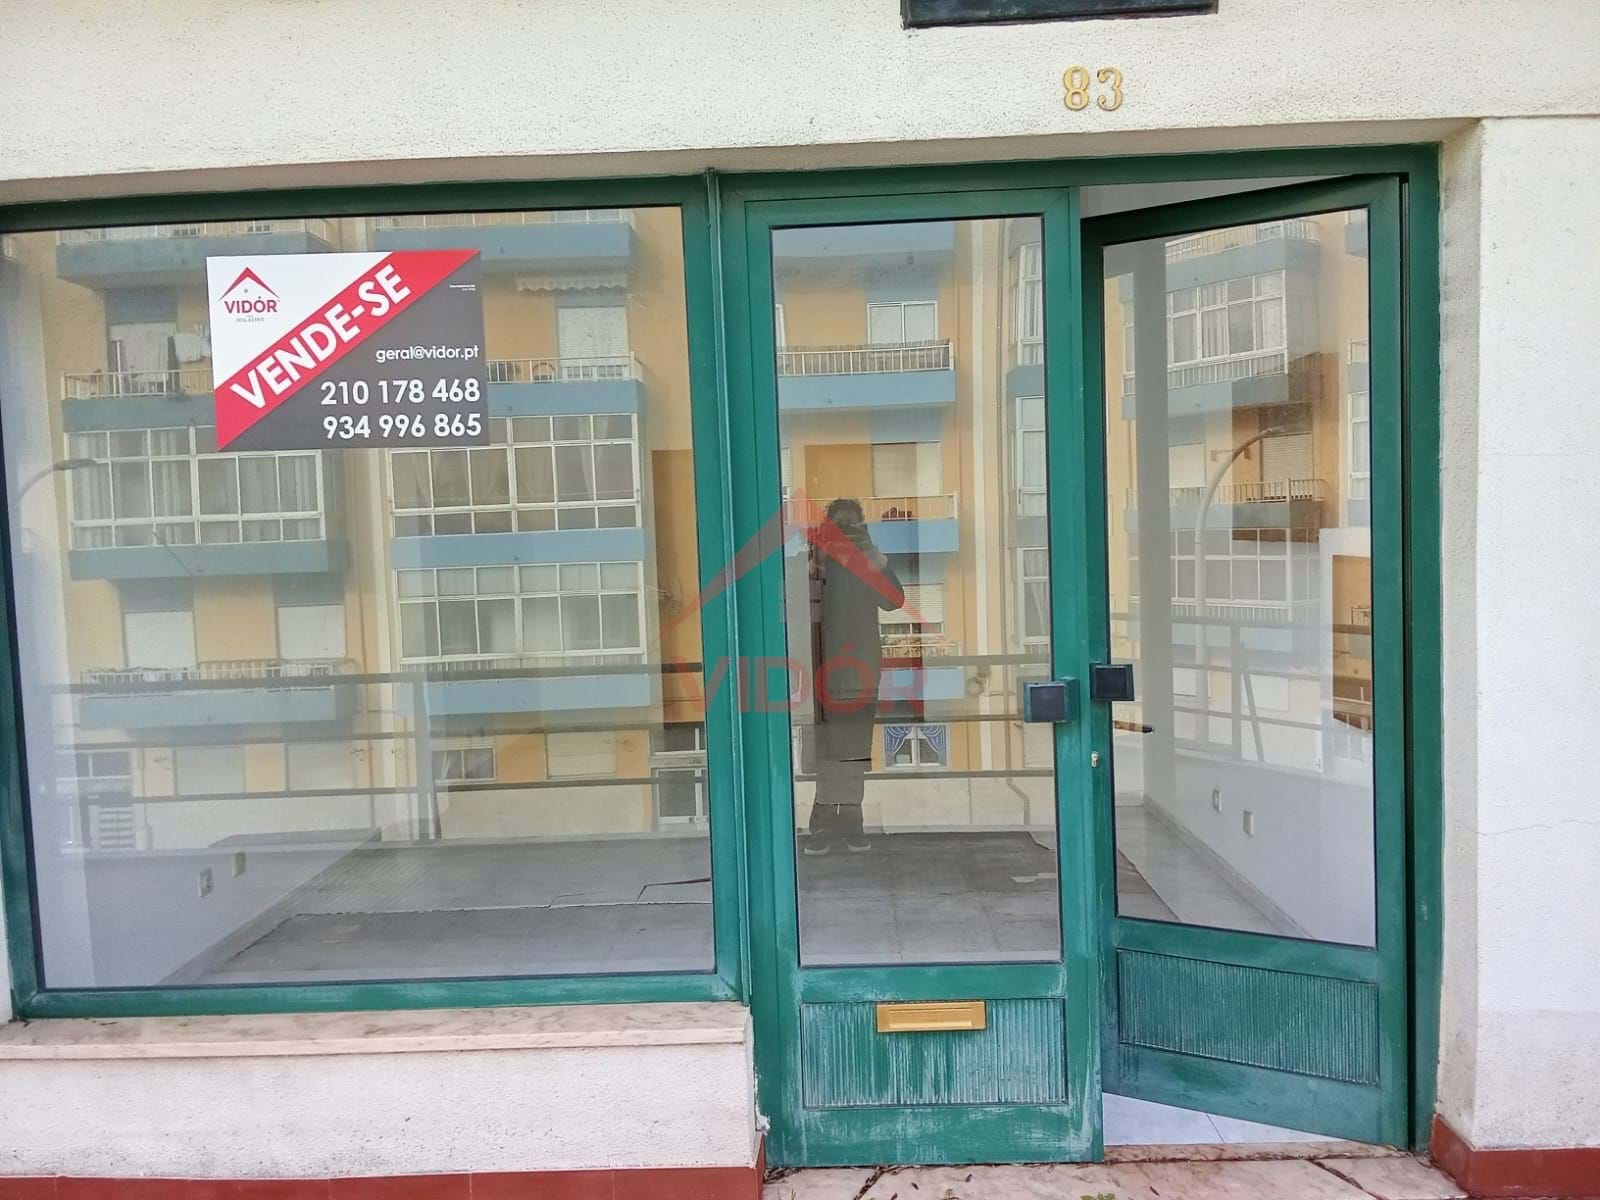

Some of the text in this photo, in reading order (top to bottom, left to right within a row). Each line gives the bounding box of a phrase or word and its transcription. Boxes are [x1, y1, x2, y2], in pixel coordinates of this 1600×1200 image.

[1063, 66, 1122, 111] 83
[229, 263, 412, 410] VENDE-SE
[376, 344, 479, 363] geral@vidor.pt
[320, 377, 481, 405] 210 178 468
[323, 413, 482, 439] 934 996 865
